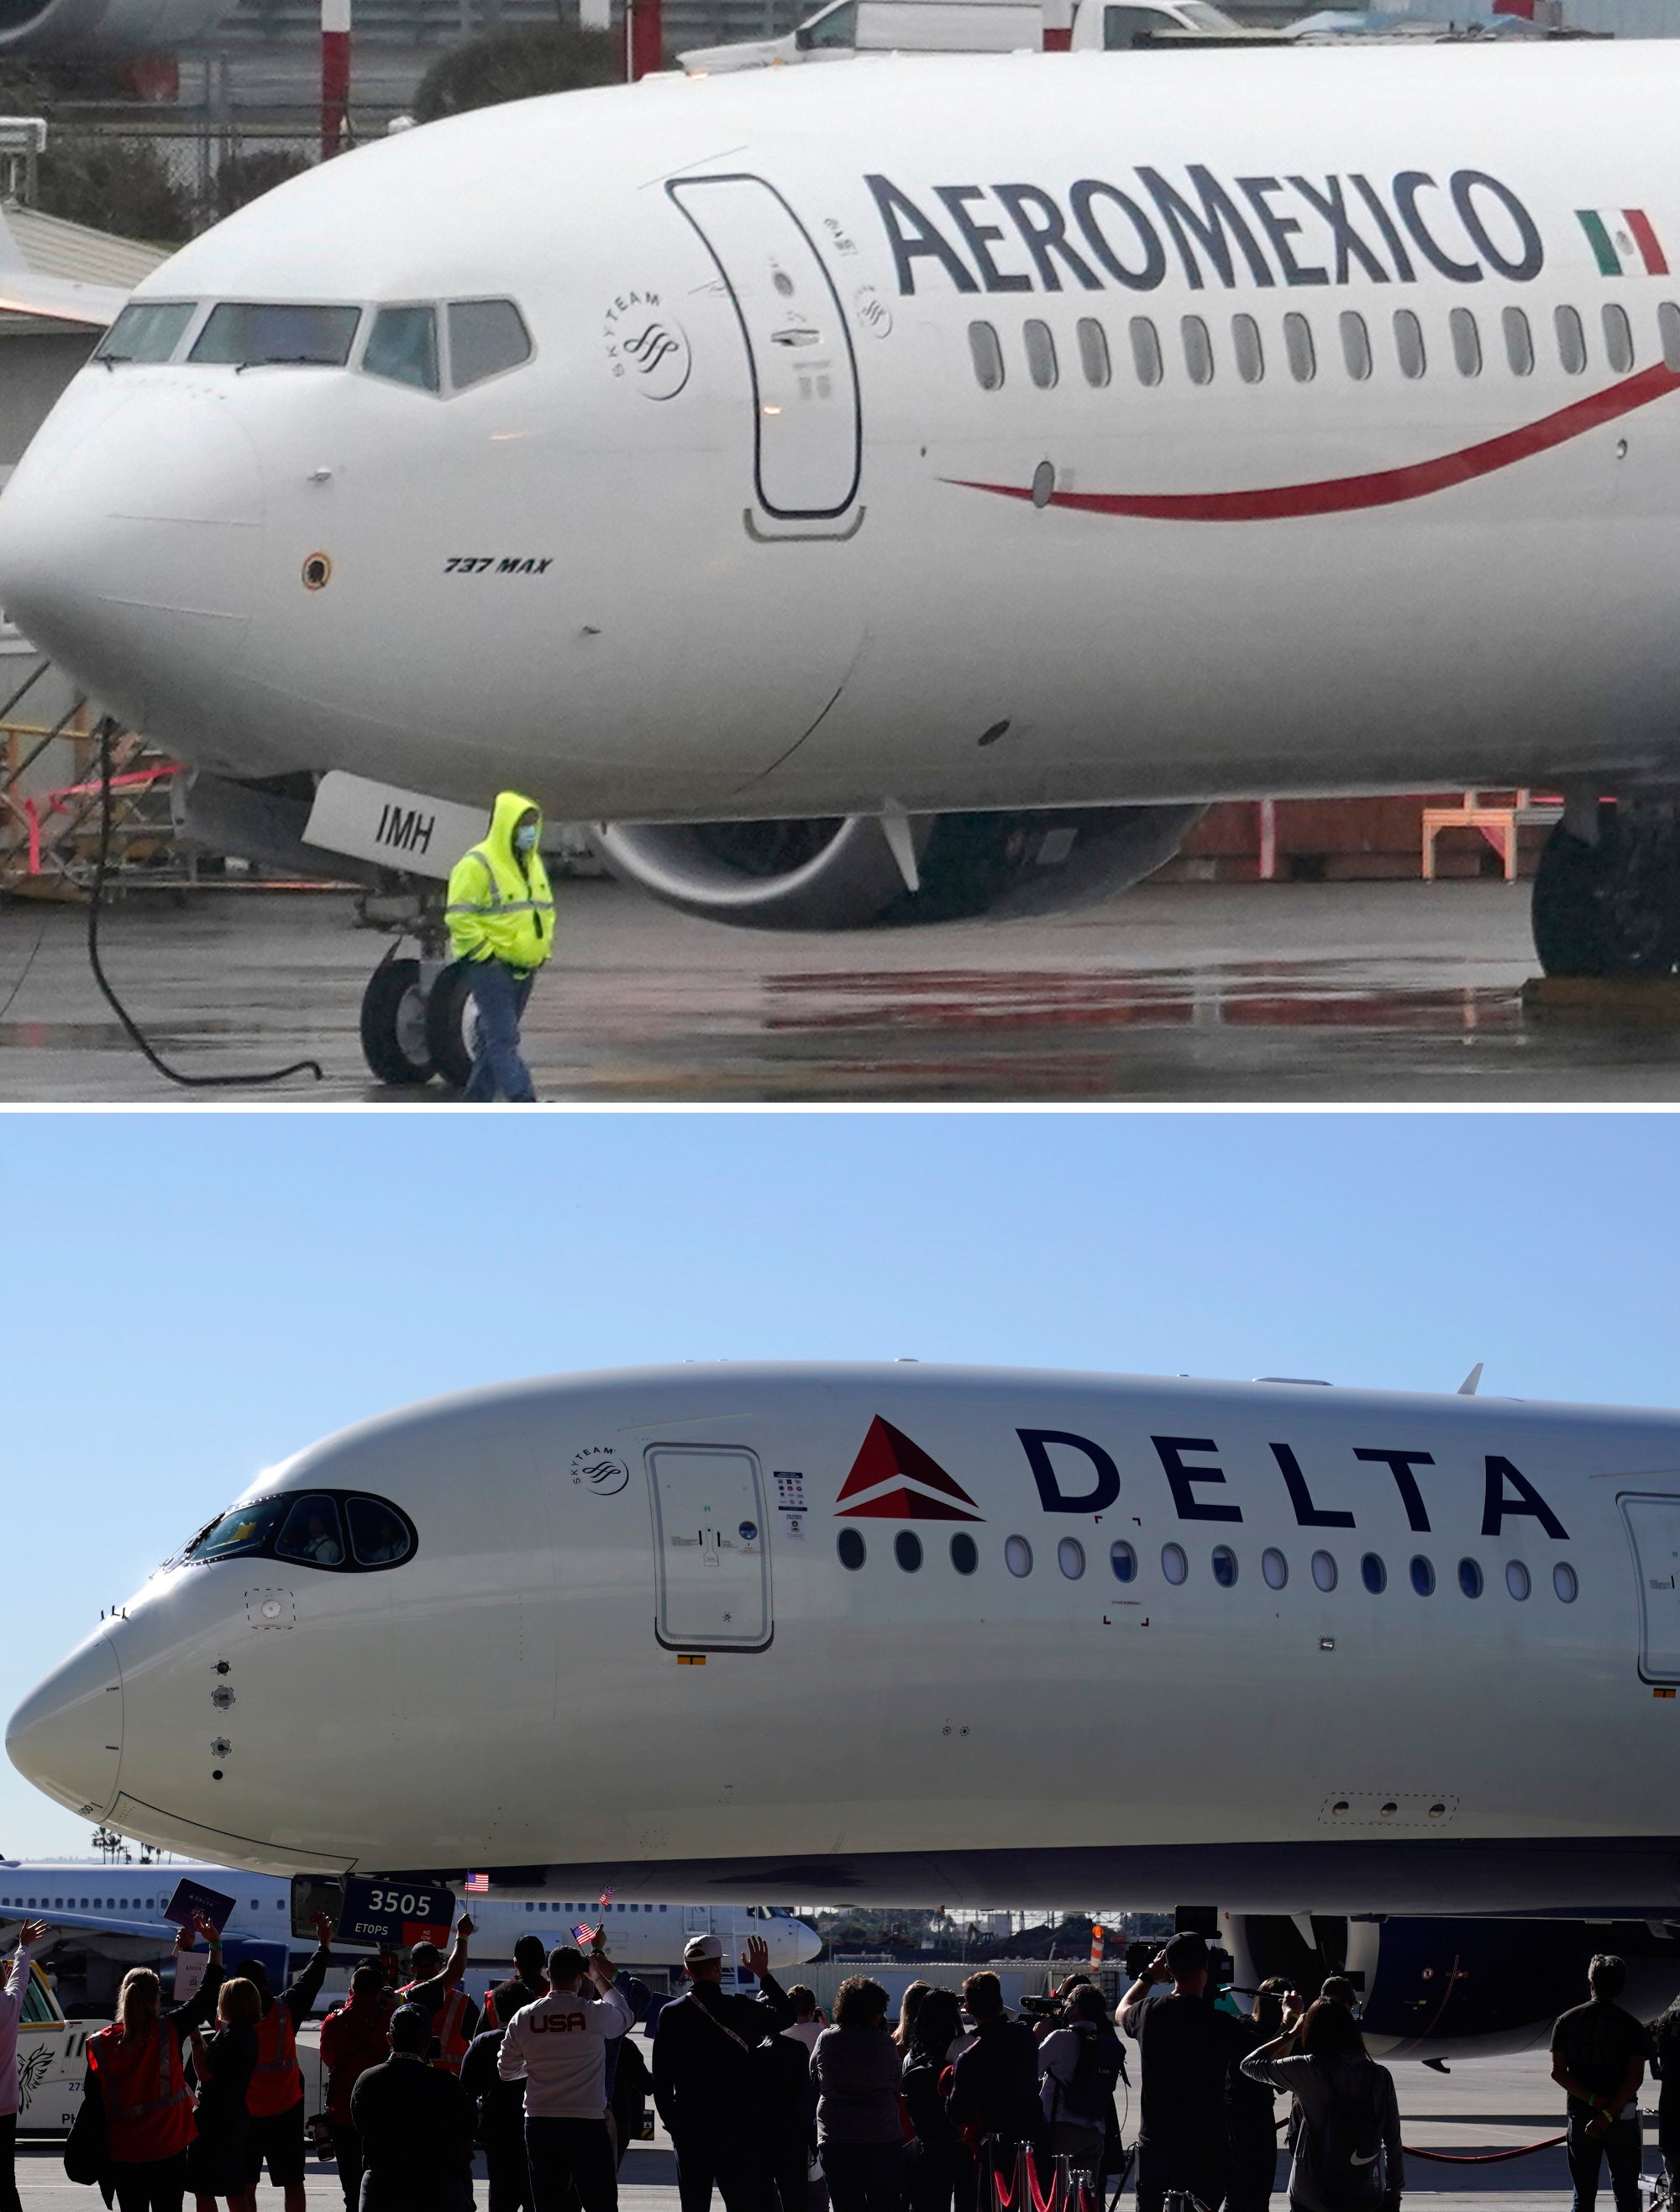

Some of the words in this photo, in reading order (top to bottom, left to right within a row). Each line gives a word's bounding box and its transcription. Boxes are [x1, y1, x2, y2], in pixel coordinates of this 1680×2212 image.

[864, 165, 1544, 296] AEROMEXICO
[604, 291, 660, 378] SKYTEAM
[444, 557, 495, 574] 737
[495, 557, 554, 574] MAX
[375, 804, 435, 855] IMH
[570, 1446, 614, 1485] SKYTEAM
[1015, 1428, 1571, 1540] DELTA
[368, 1890, 432, 1916] 3505
[354, 1922, 389, 1936] ETOPS
[529, 2012, 586, 2034] USA
